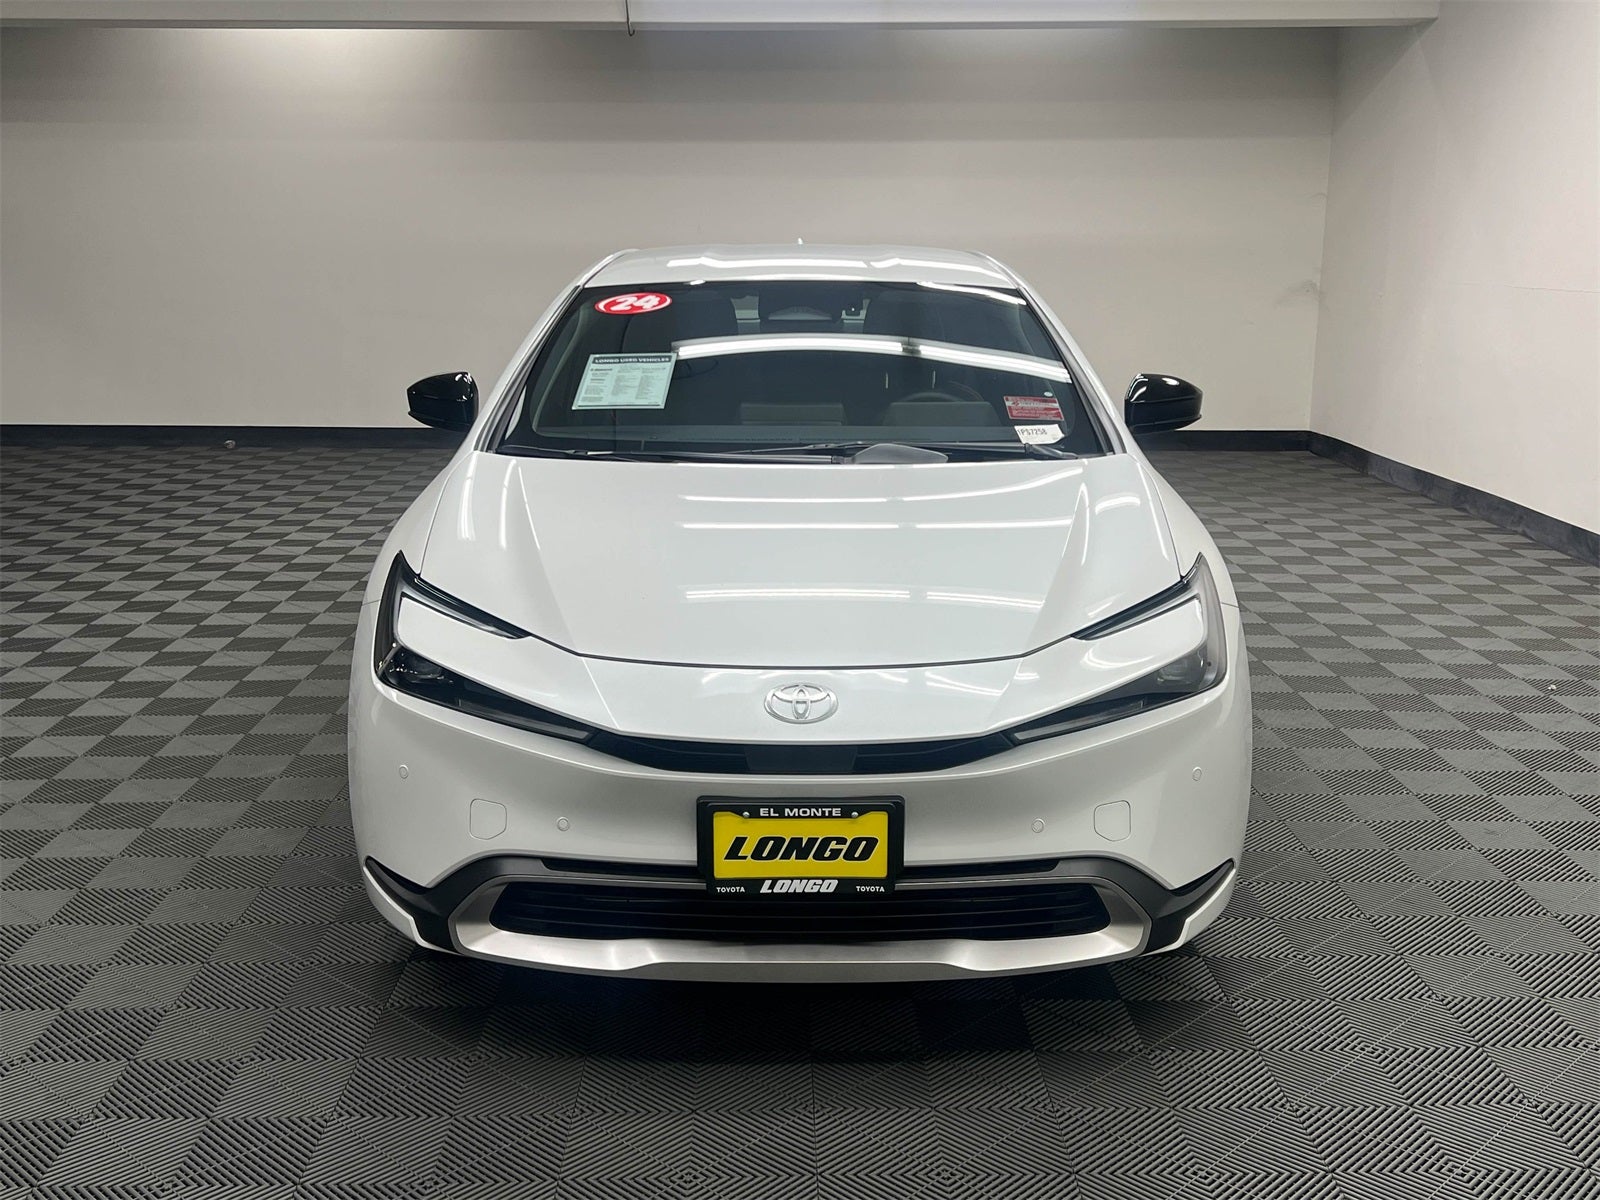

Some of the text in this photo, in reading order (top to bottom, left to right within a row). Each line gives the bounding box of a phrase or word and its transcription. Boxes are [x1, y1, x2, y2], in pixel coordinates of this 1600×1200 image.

[610, 295, 660, 311] 24
[760, 808, 842, 817] EL MONTE
[723, 836, 879, 862] LONGO
[760, 879, 839, 893] LONGO
[855, 885, 885, 893] TOYOTA
